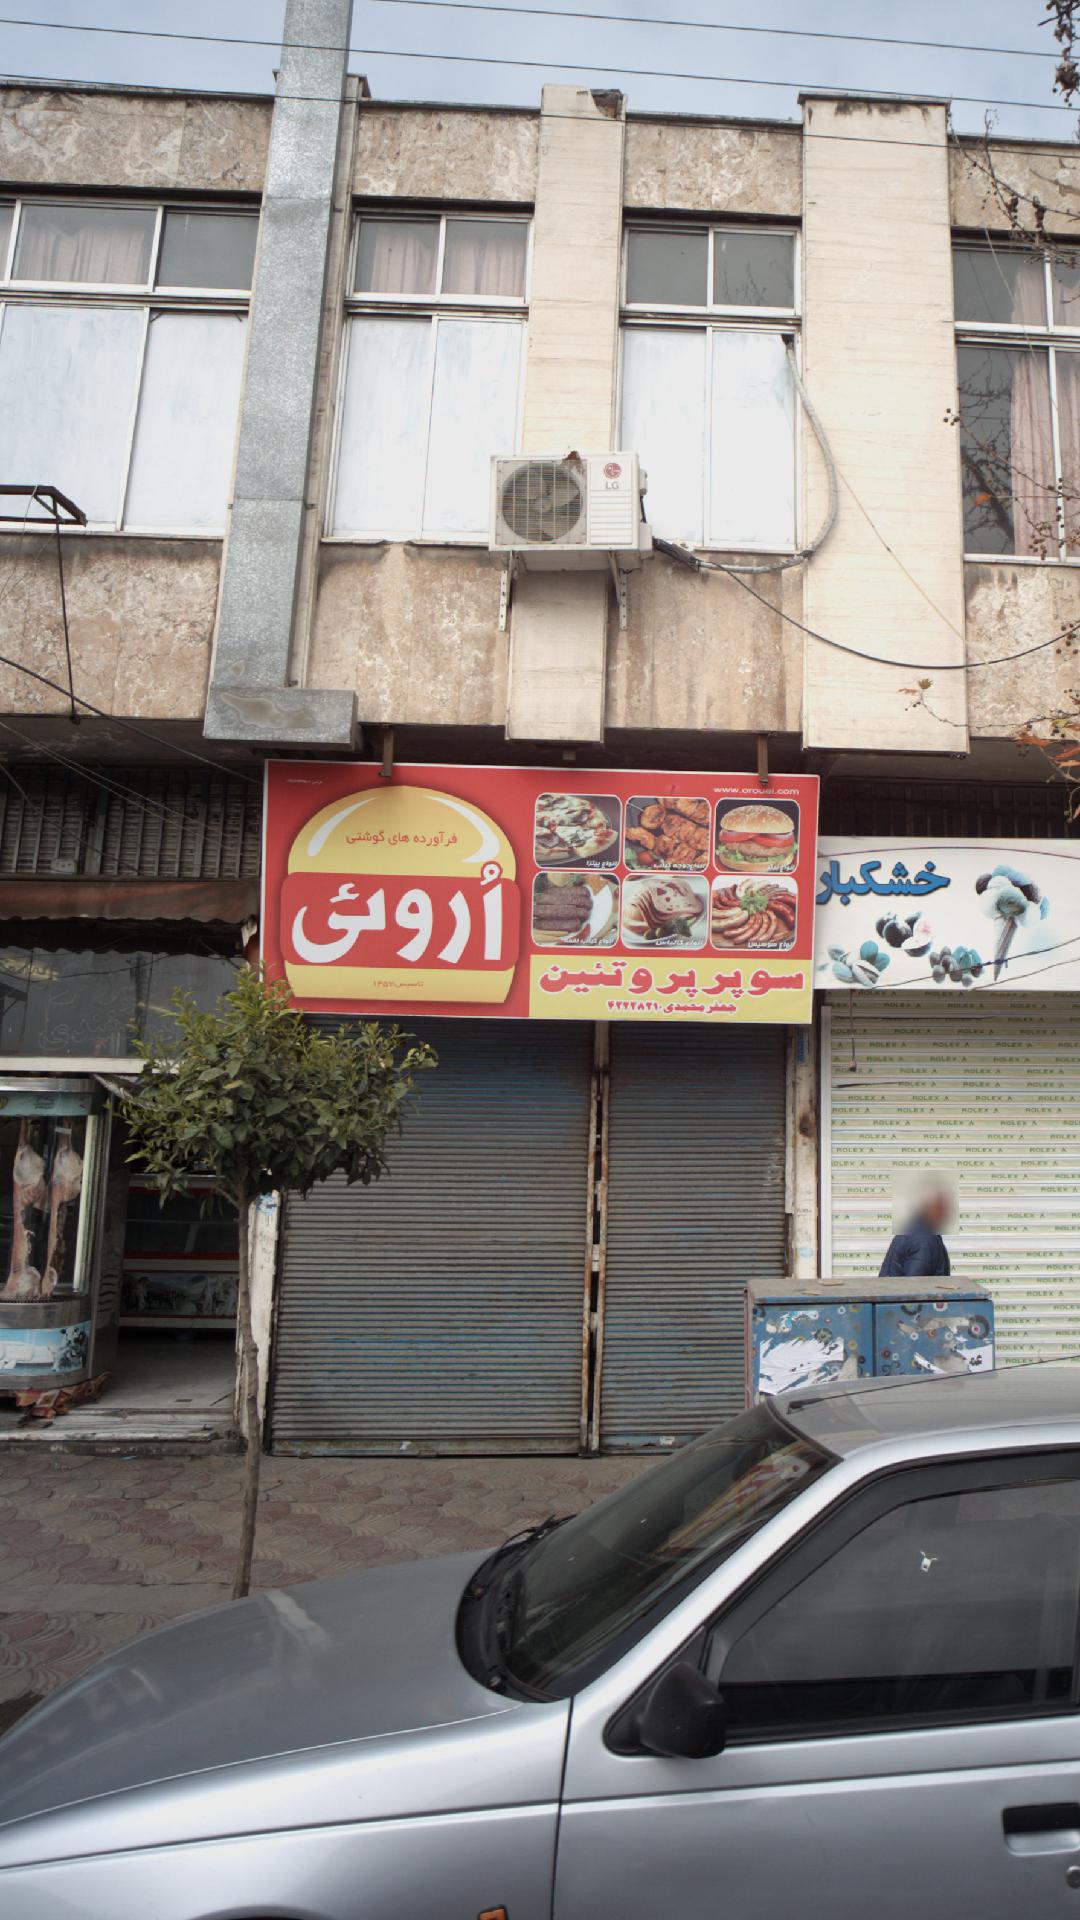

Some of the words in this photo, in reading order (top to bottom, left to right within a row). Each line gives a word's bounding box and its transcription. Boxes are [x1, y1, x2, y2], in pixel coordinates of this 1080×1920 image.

[605, 482, 620, 490] LG
[346, 830, 385, 845] گوشتی
[387, 832, 410, 846] های
[413, 831, 458, 847] فرآورده
[816, 860, 951, 905] خشکبار
[539, 960, 699, 998] پروتئین
[701, 968, 804, 999] سوپر
